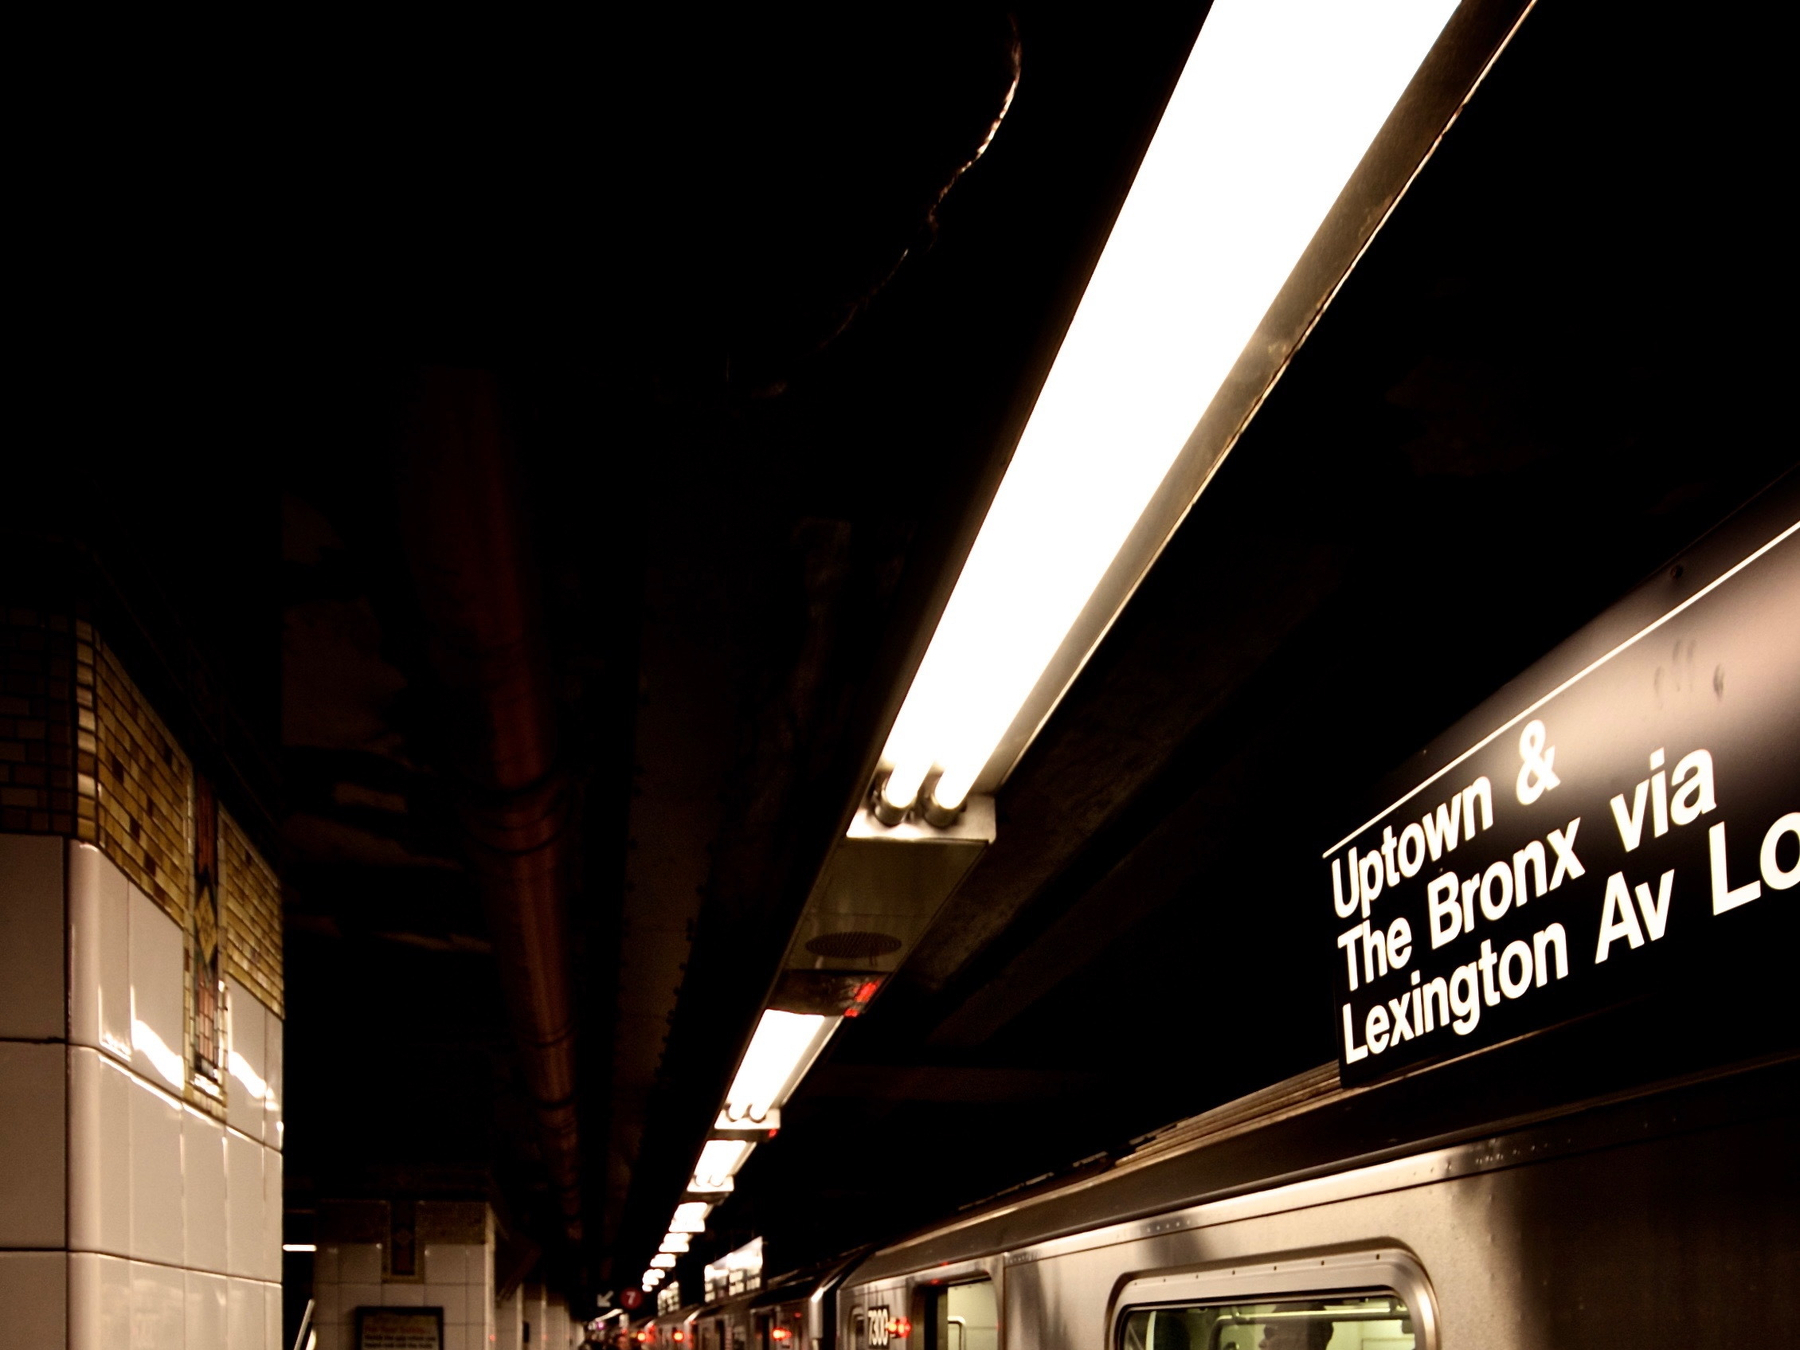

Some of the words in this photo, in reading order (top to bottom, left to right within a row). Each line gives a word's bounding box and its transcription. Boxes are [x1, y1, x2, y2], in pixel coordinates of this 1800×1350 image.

[1332, 776, 1493, 918] Uptown
[1516, 719, 1561, 805] &
[1337, 916, 1412, 991] The
[1427, 817, 1586, 949] Bronx
[1610, 747, 1717, 852] via
[1342, 922, 1568, 1064] Lexington
[1595, 869, 1675, 964] Av
[626, 1290, 637, 1305] 7
